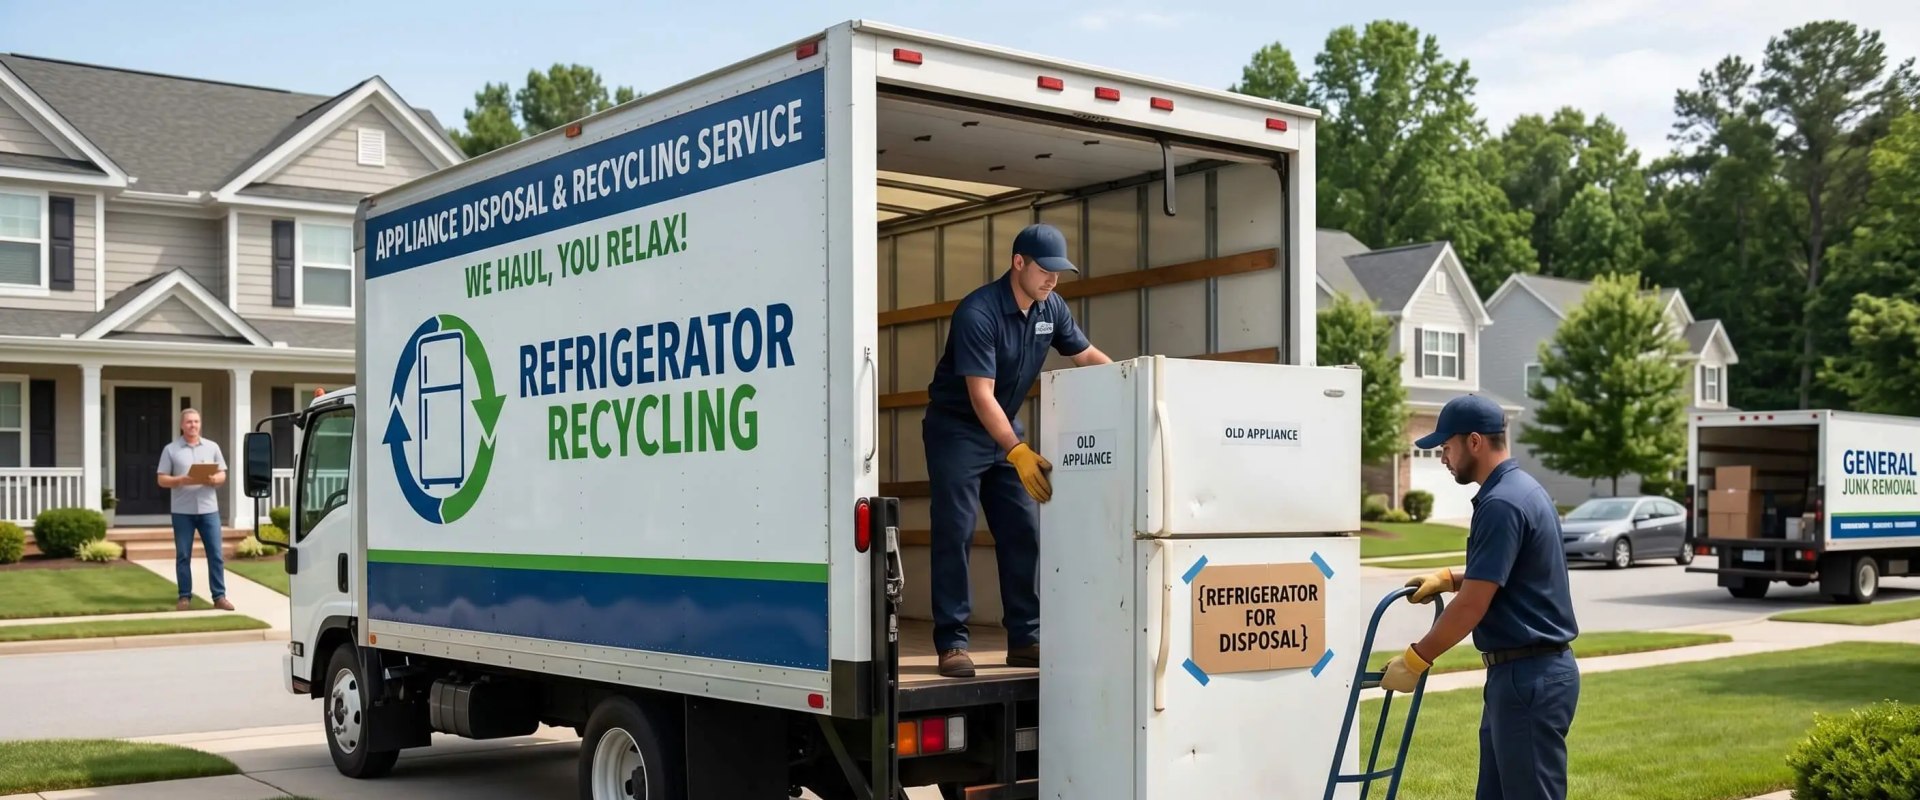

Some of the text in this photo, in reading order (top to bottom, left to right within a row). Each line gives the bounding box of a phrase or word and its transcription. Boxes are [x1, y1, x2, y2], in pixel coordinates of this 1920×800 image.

[375, 99, 803, 261] APPLIANCE DISPOSAL & RECYCLING SERVICE
[465, 212, 688, 298] WE HAUL, YOU RELAX!
[519, 303, 795, 398] REFRIGERATOR
[548, 383, 759, 461] RECYCLING
[1077, 434, 1096, 449] OLD
[1225, 427, 1298, 441] OLD APPLIANCE
[1062, 451, 1112, 467] APPLIANCE
[1843, 449, 1917, 476] GENERAL
[1842, 478, 1918, 495] JUNK REMOVAL
[1246, 608, 1276, 627] FOR
